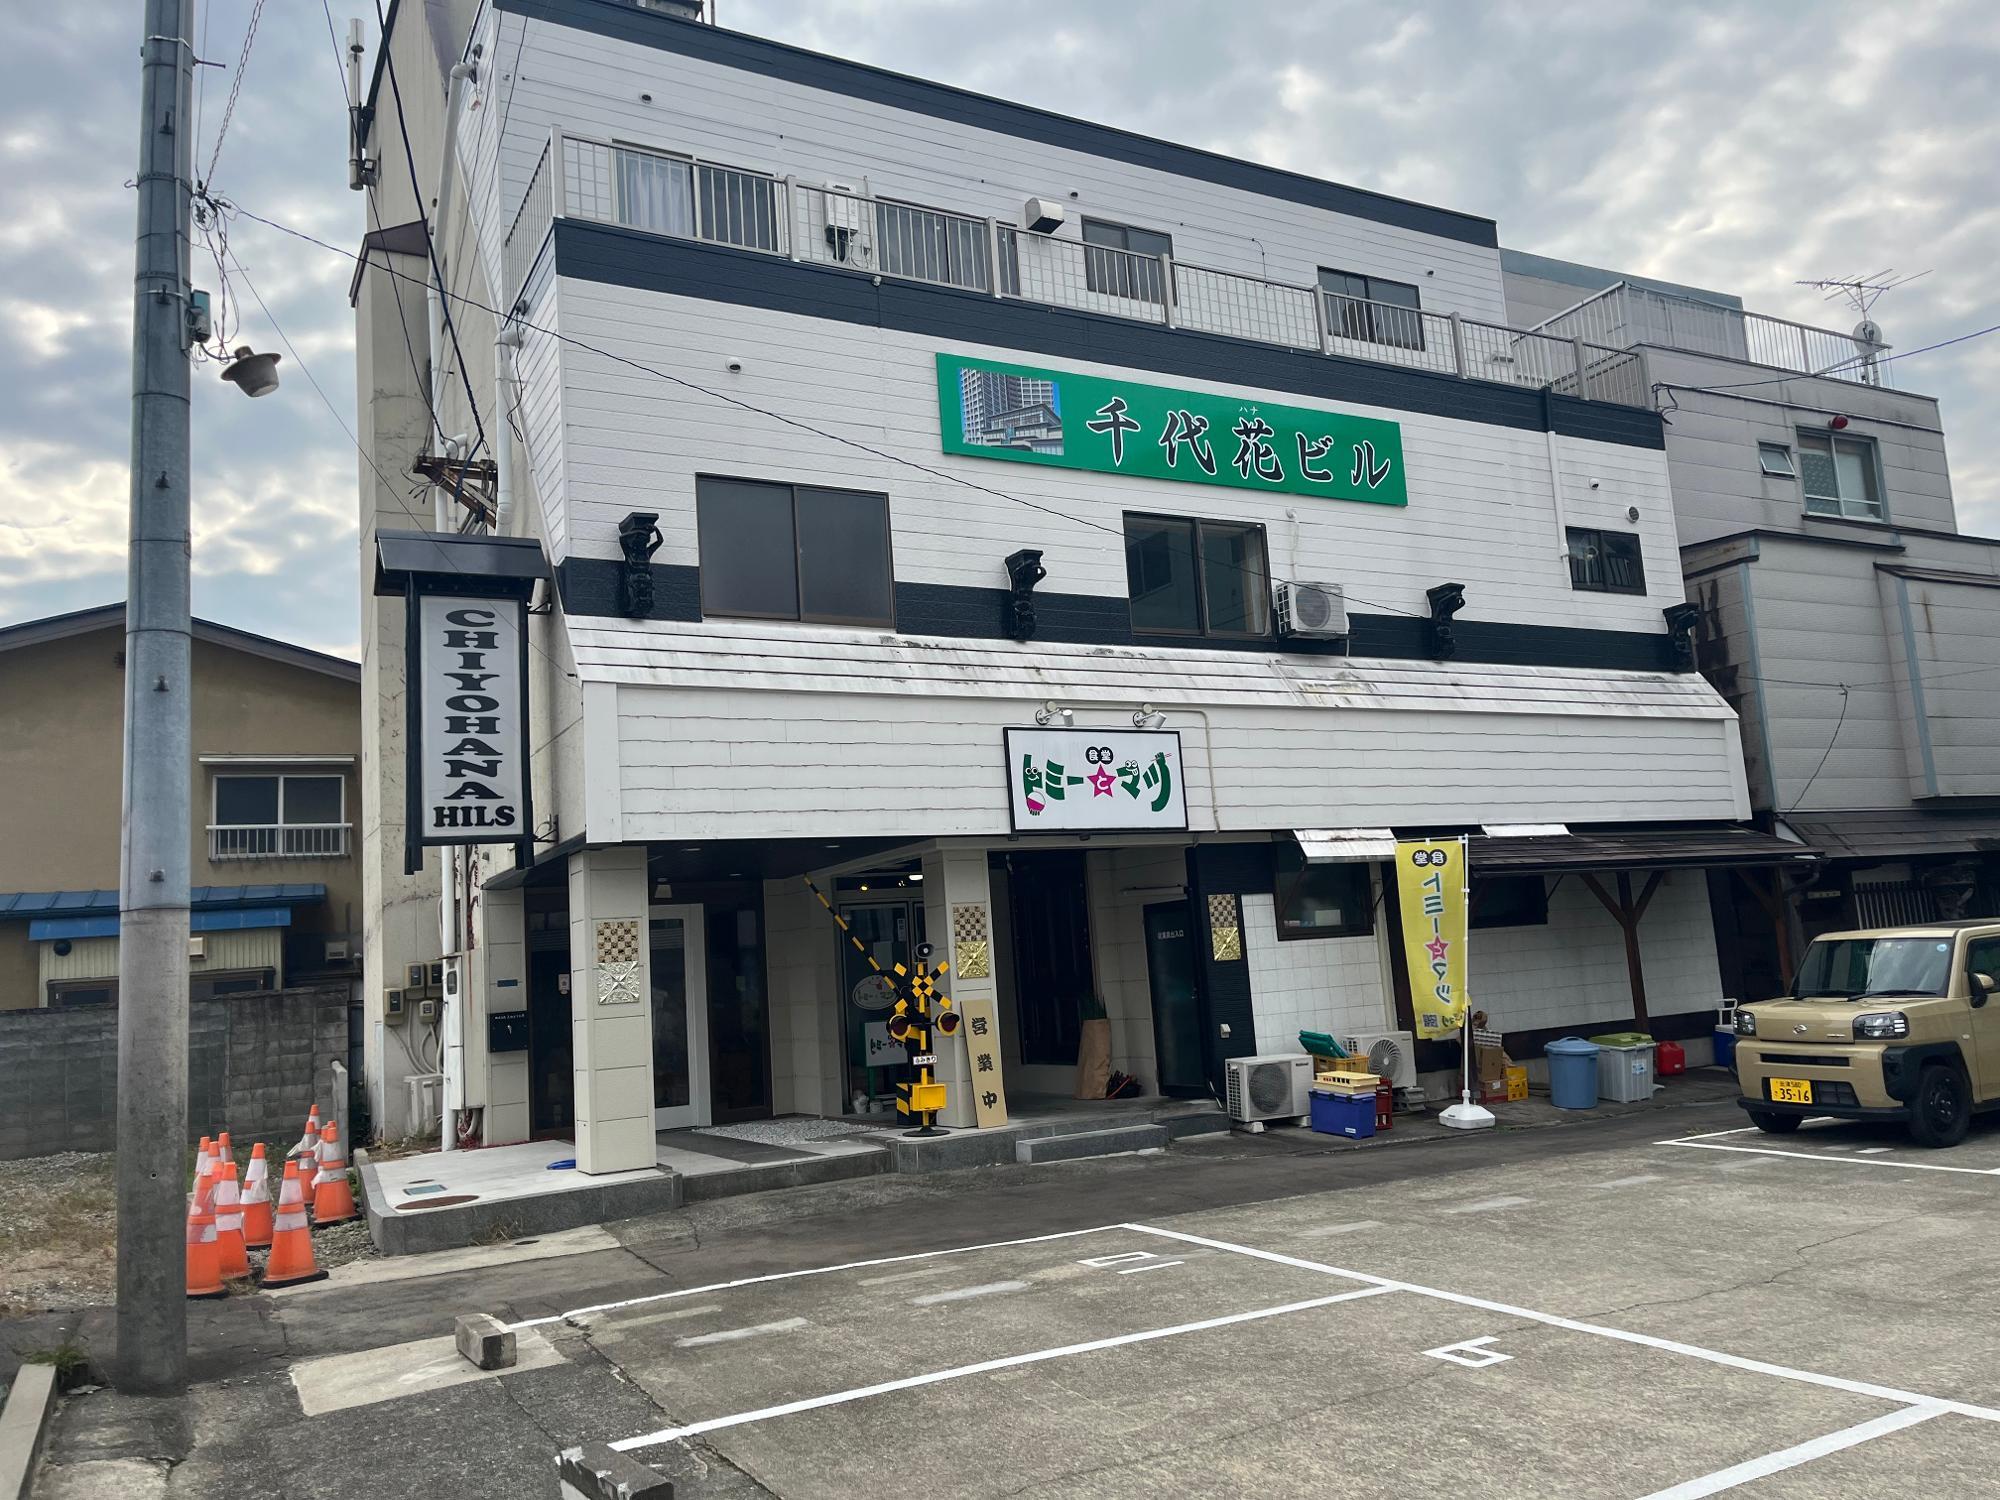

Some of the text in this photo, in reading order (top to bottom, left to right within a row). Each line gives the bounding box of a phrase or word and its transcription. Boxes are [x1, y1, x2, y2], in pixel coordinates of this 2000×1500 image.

[1086, 397, 1391, 489] 千代花ビル
[442, 609, 504, 800] CHIYOHANA
[1088, 748, 1112, 762] 食堂
[433, 805, 515, 828] HILS
[971, 1017, 998, 1109] 営業中
